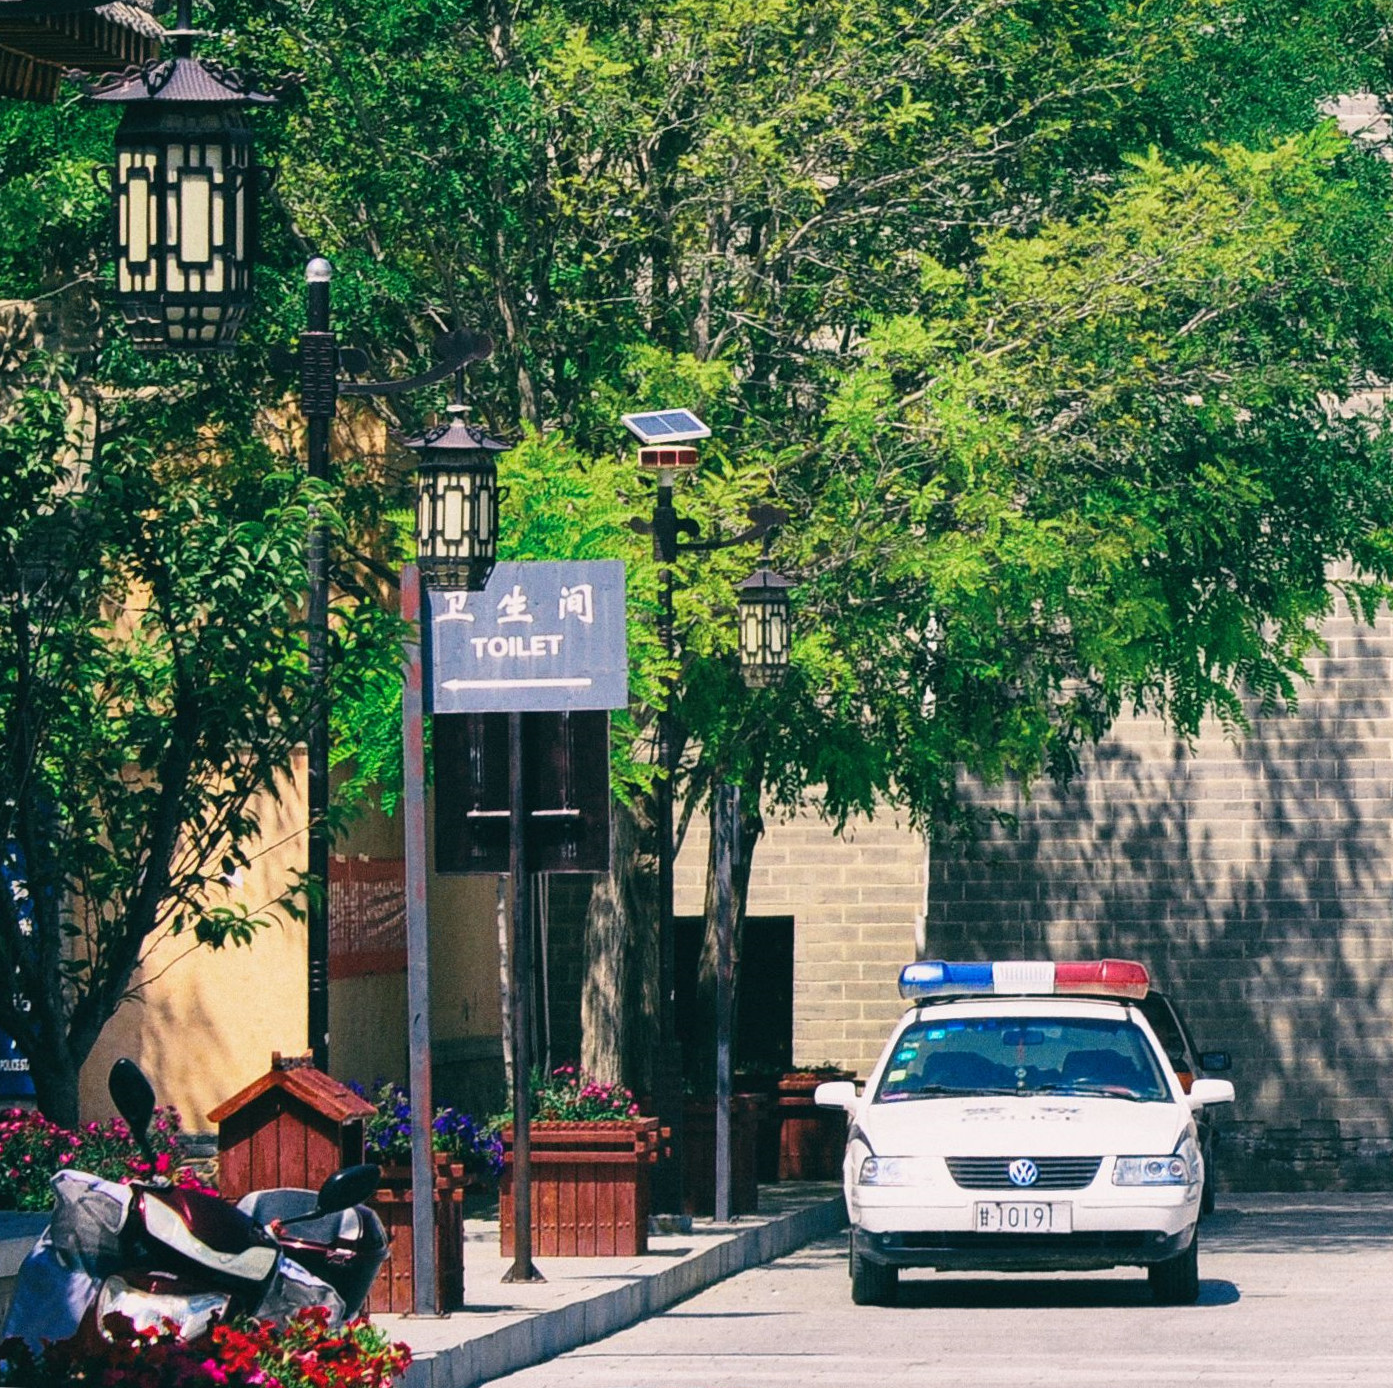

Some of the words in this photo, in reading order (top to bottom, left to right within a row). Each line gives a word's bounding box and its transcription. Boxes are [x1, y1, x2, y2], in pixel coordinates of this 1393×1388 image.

[435, 584, 593, 624] 卫生间
[470, 635, 564, 659] TOILET
[1009, 1159, 1038, 1186] VW
